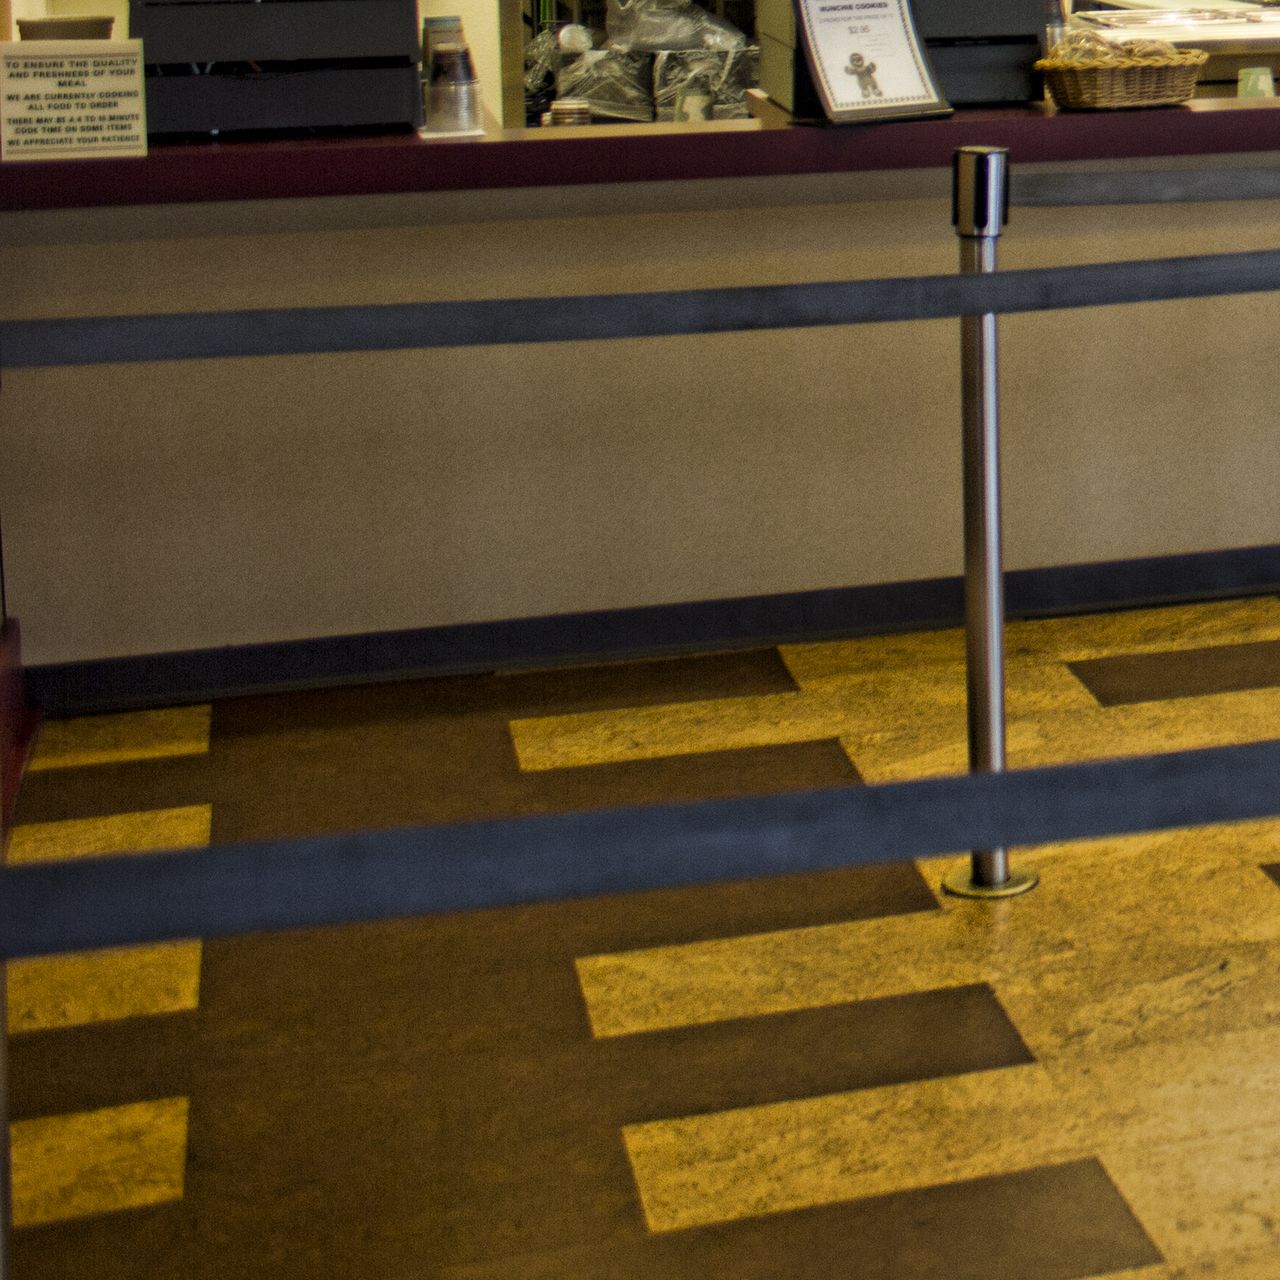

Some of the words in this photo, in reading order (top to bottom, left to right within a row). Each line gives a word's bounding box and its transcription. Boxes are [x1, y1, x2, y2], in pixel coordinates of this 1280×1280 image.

[23, 61, 65, 69] ENSURE
[69, 60, 88, 68] THE
[92, 58, 138, 67] QUALITY
[33, 70, 90, 78] FRESHNESS
[110, 68, 136, 76] YOUR
[23, 93, 41, 101] ARE
[45, 92, 96, 100] CURRENTLY
[99, 90, 139, 99] COOKING
[47, 102, 72, 110] FOOD
[89, 101, 119, 109] ORDER
